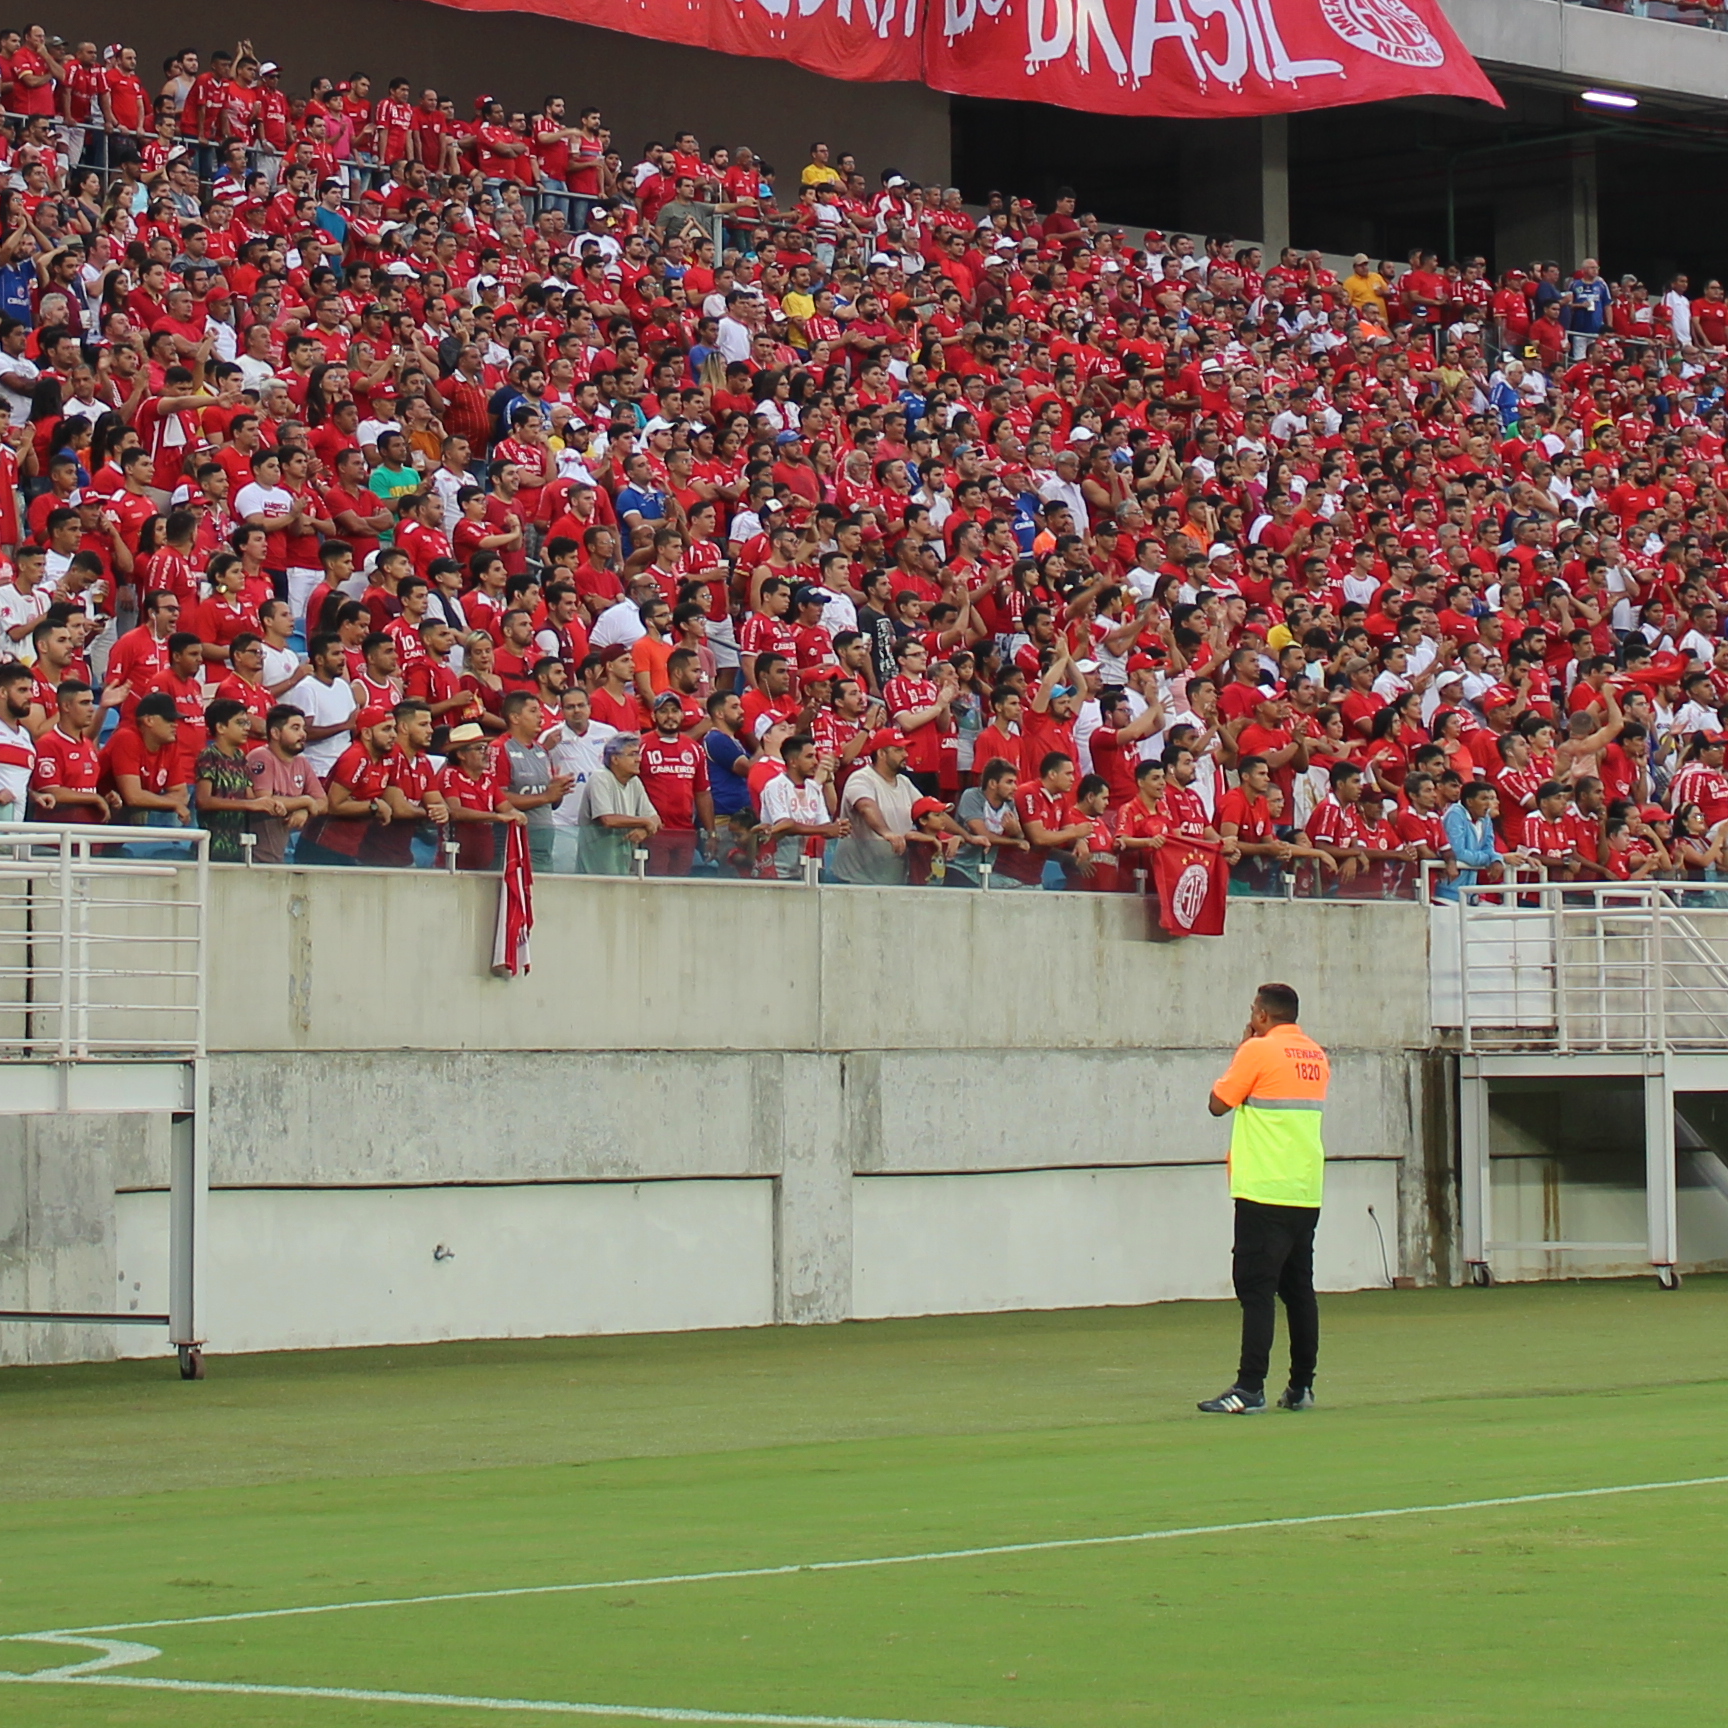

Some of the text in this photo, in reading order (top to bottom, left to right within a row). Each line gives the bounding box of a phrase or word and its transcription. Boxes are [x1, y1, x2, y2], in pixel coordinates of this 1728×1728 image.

[401, 635, 416, 651] 10
[646, 749, 663, 765] 10
[1283, 1047, 1324, 1061] STEWARD
[1294, 1062, 1321, 1081] 1820
